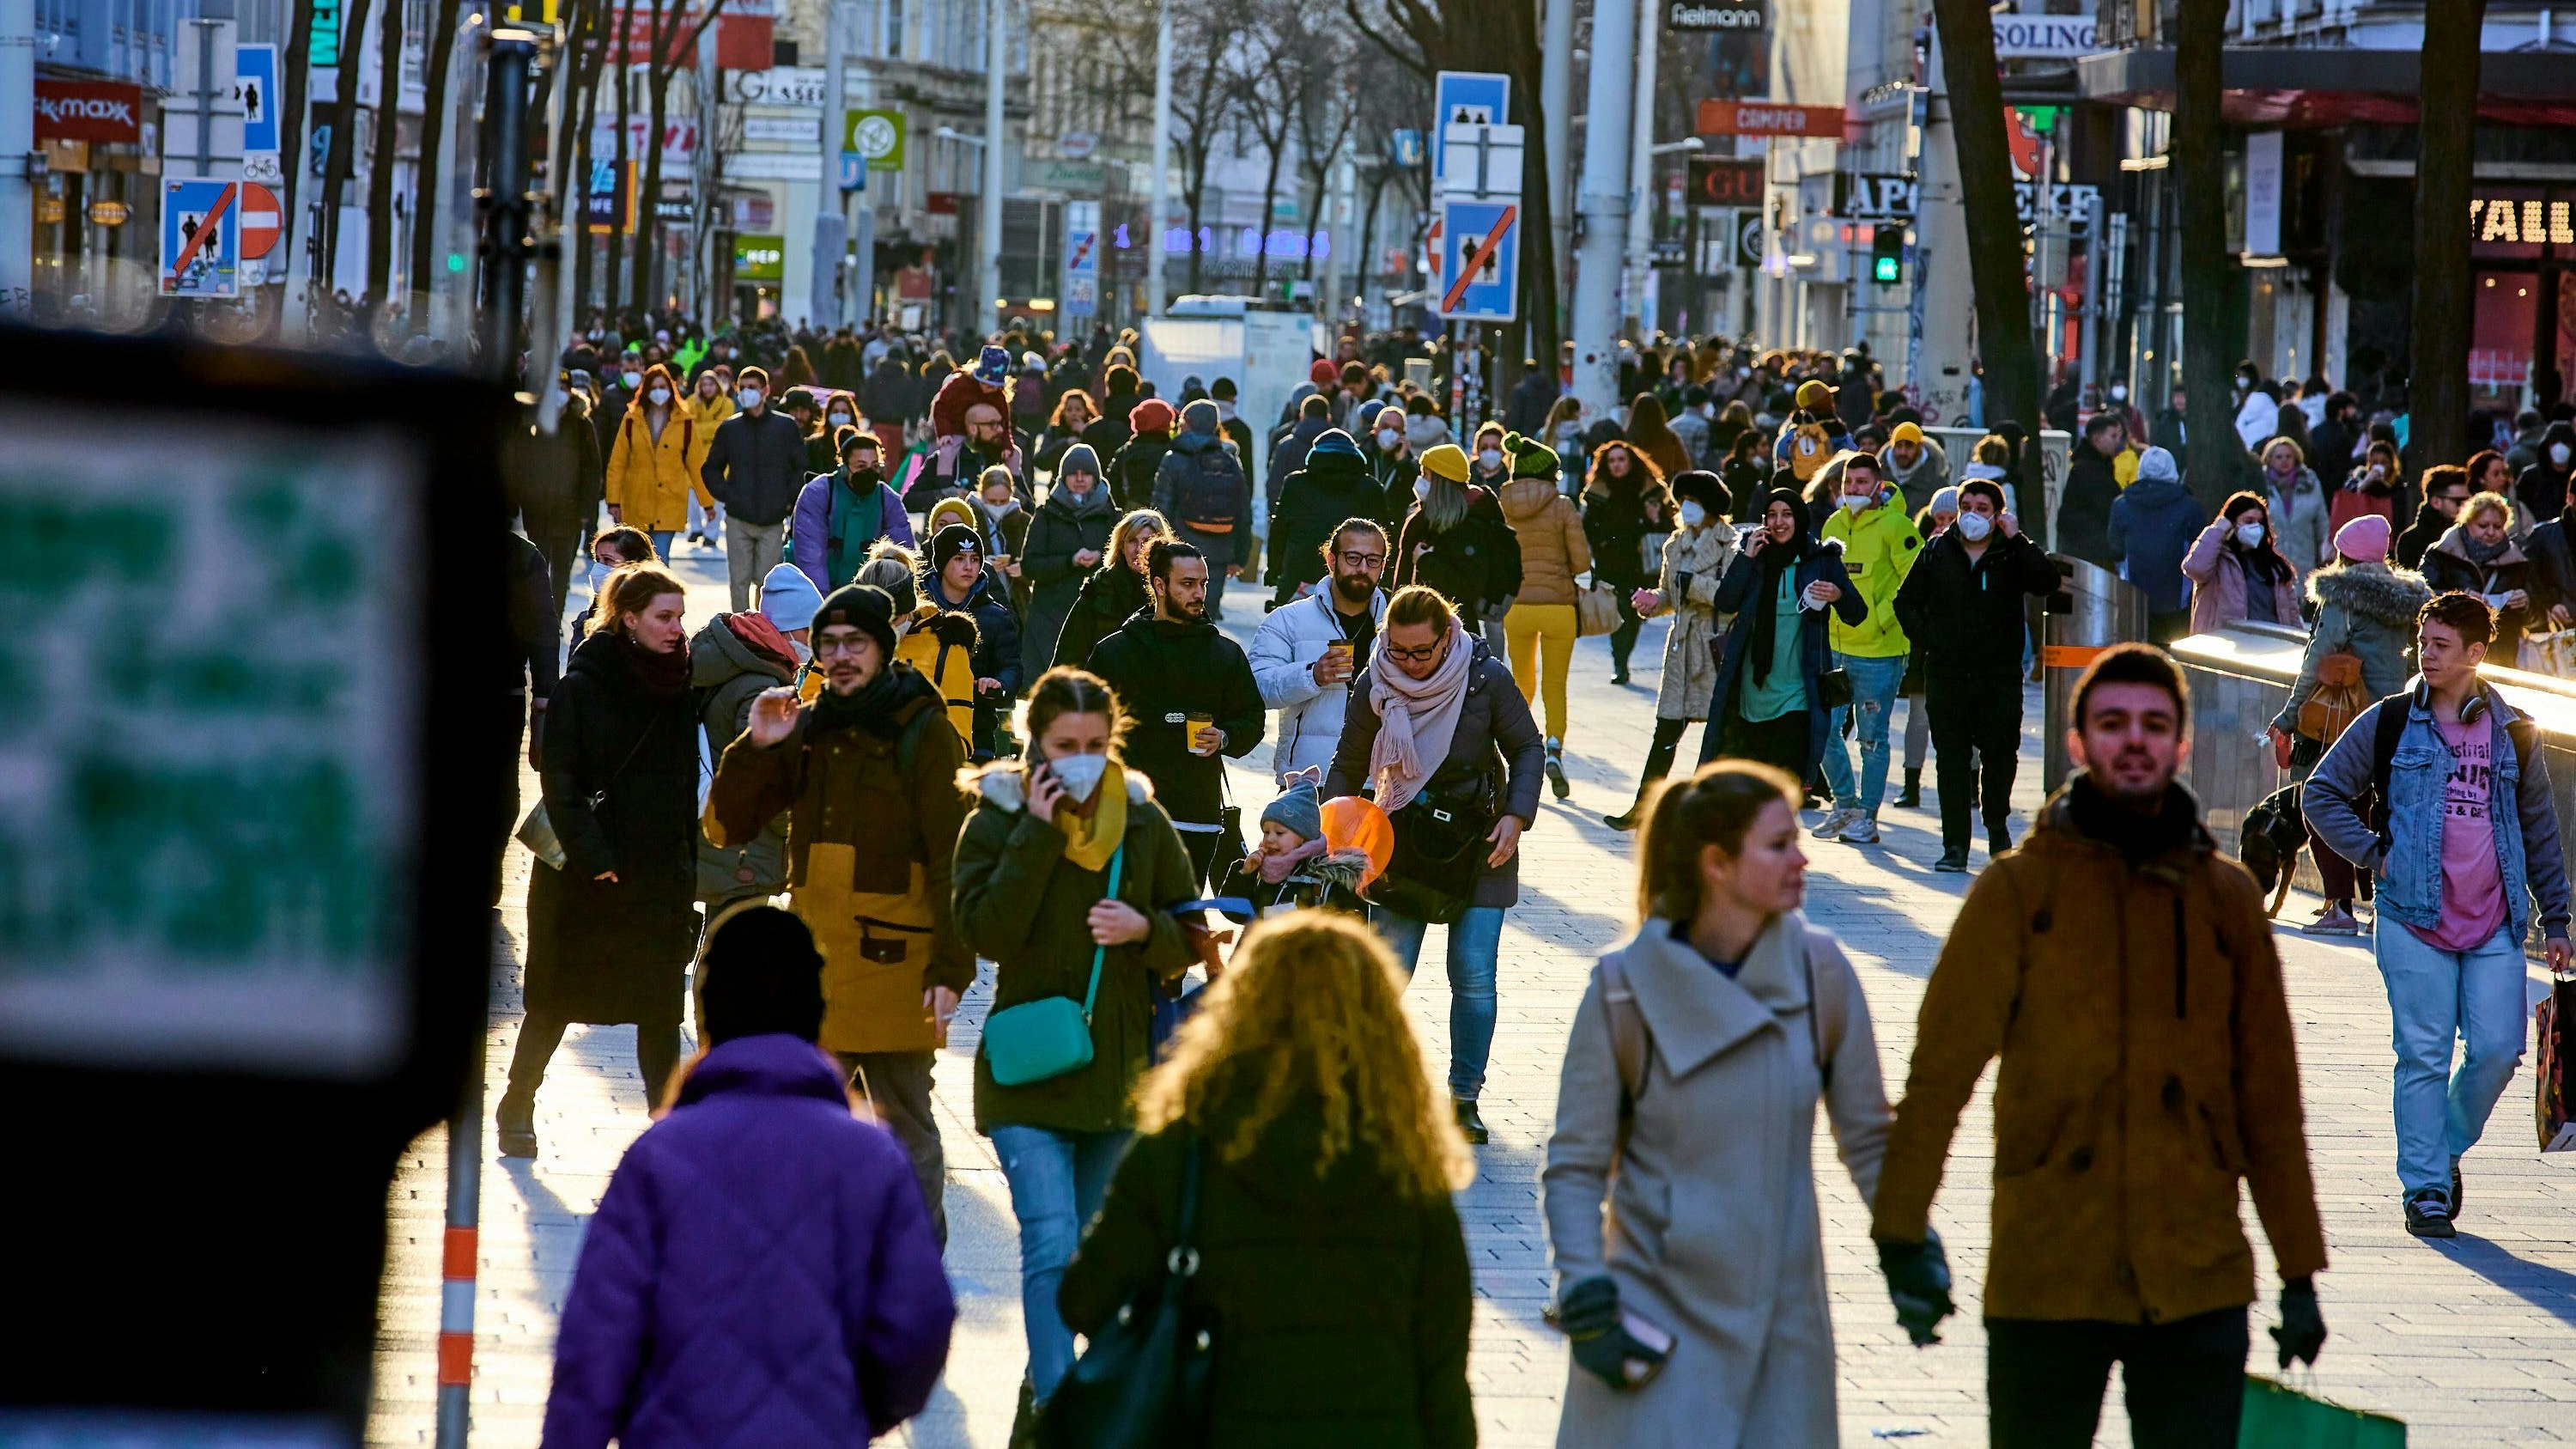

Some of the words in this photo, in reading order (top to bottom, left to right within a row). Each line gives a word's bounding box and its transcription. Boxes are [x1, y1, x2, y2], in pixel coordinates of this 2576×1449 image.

[1993, 22, 2097, 48] SOLING
[1737, 108, 1807, 131] CAMPER
[2456, 805, 2467, 816] &
